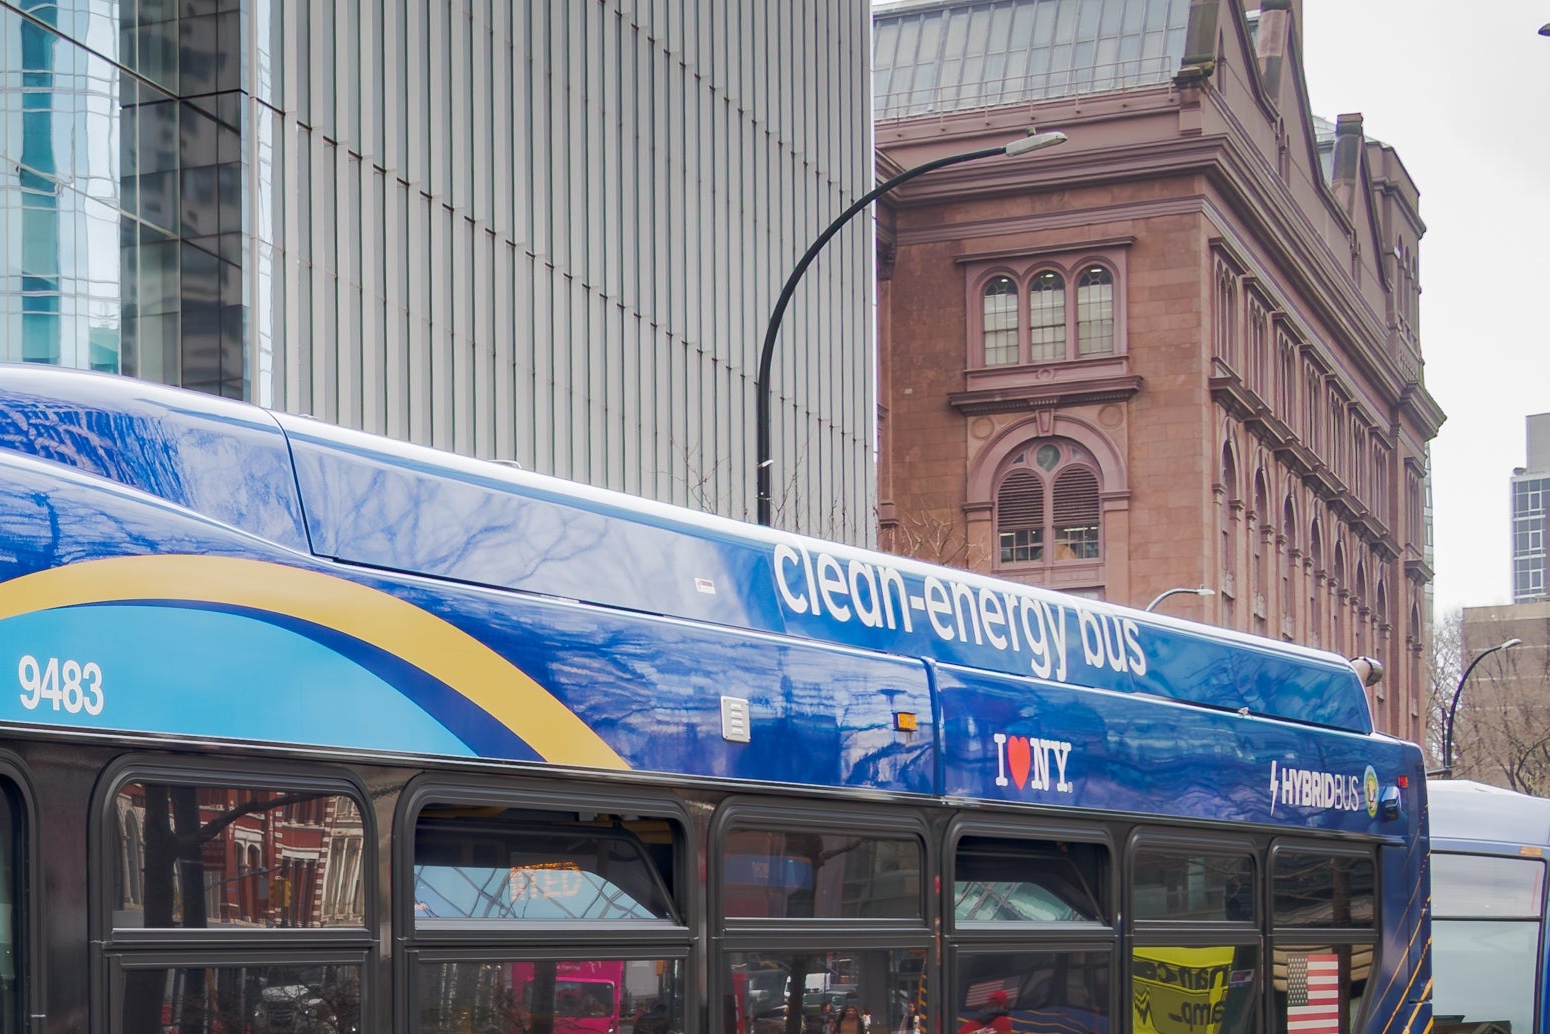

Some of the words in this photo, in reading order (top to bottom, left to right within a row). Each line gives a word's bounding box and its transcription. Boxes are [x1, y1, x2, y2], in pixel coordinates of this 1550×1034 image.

[774, 540, 1067, 683] clean-energy
[1077, 604, 1147, 677] bus
[18, 655, 104, 715] 9483
[1281, 767, 1359, 811] HYBRIDBUS
